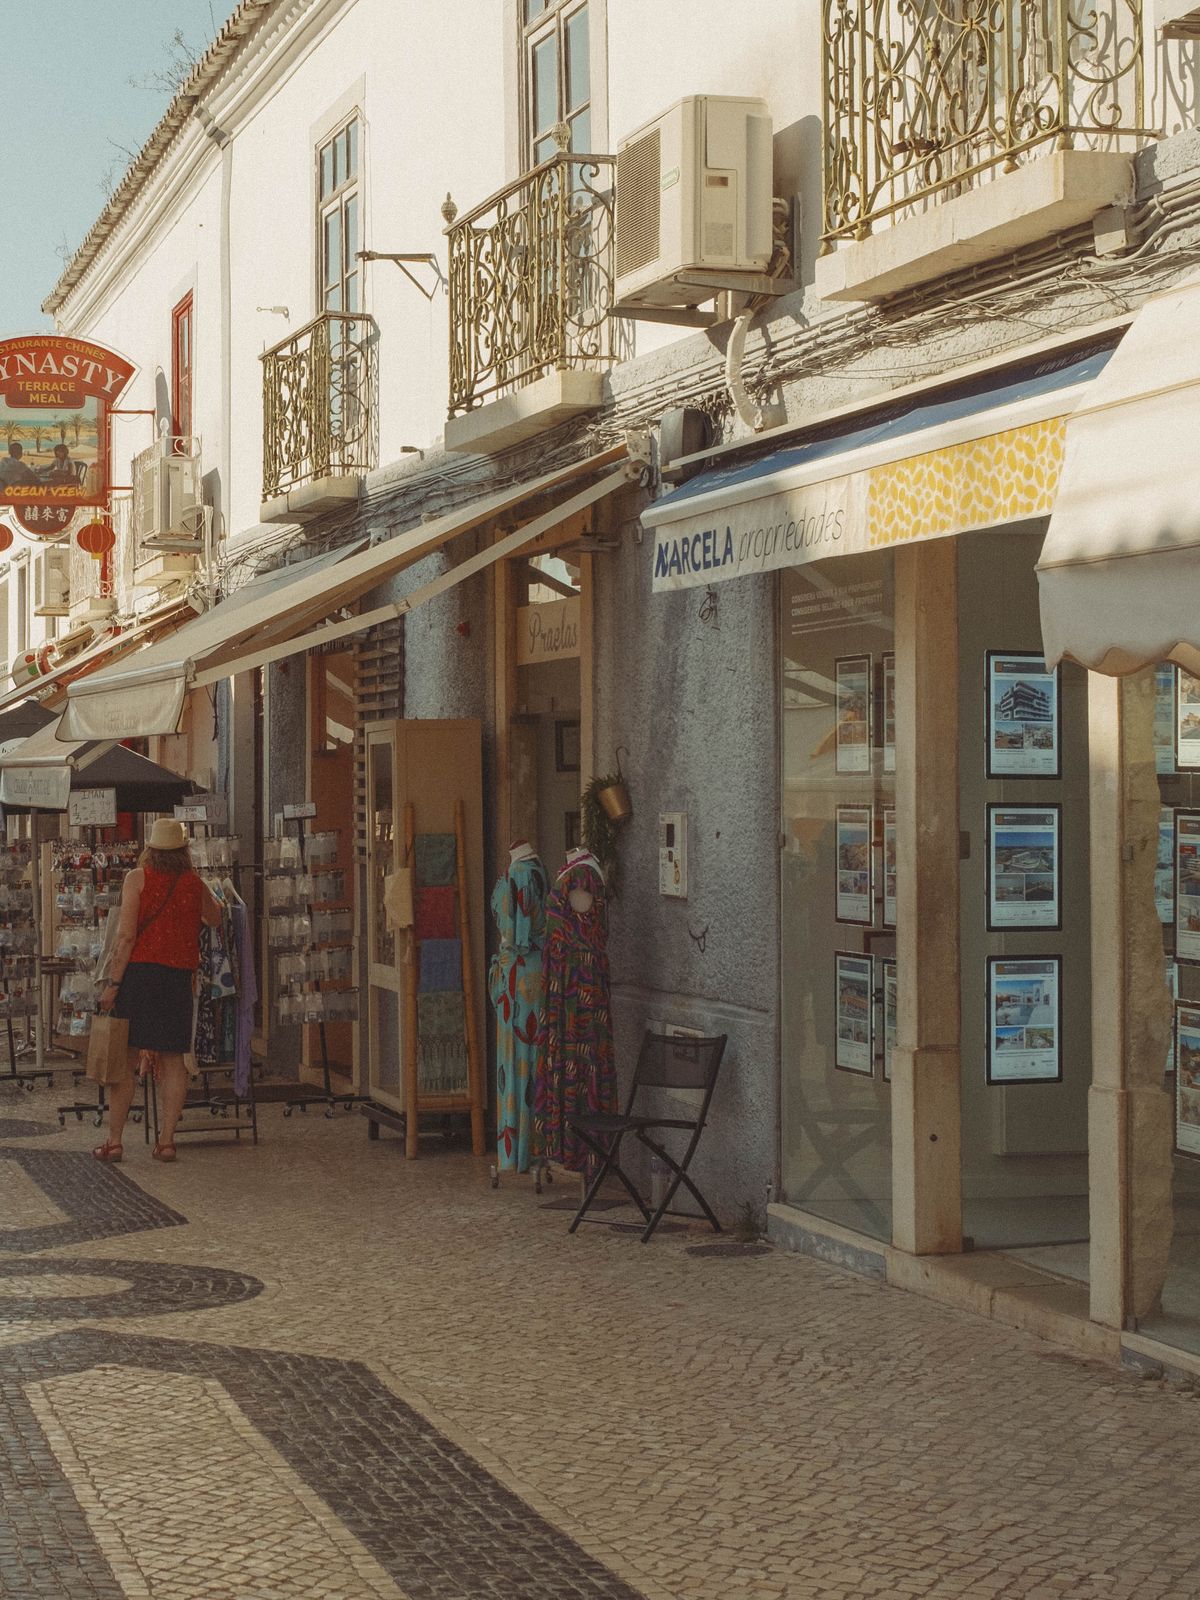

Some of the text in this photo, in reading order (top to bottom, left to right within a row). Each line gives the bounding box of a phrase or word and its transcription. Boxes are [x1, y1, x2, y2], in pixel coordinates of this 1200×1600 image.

[17, 381, 76, 392] TERRACE
[29, 393, 65, 404] MEAL
[4, 485, 47, 497] OCEAN
[655, 502, 845, 578] MARCELA propriedades
